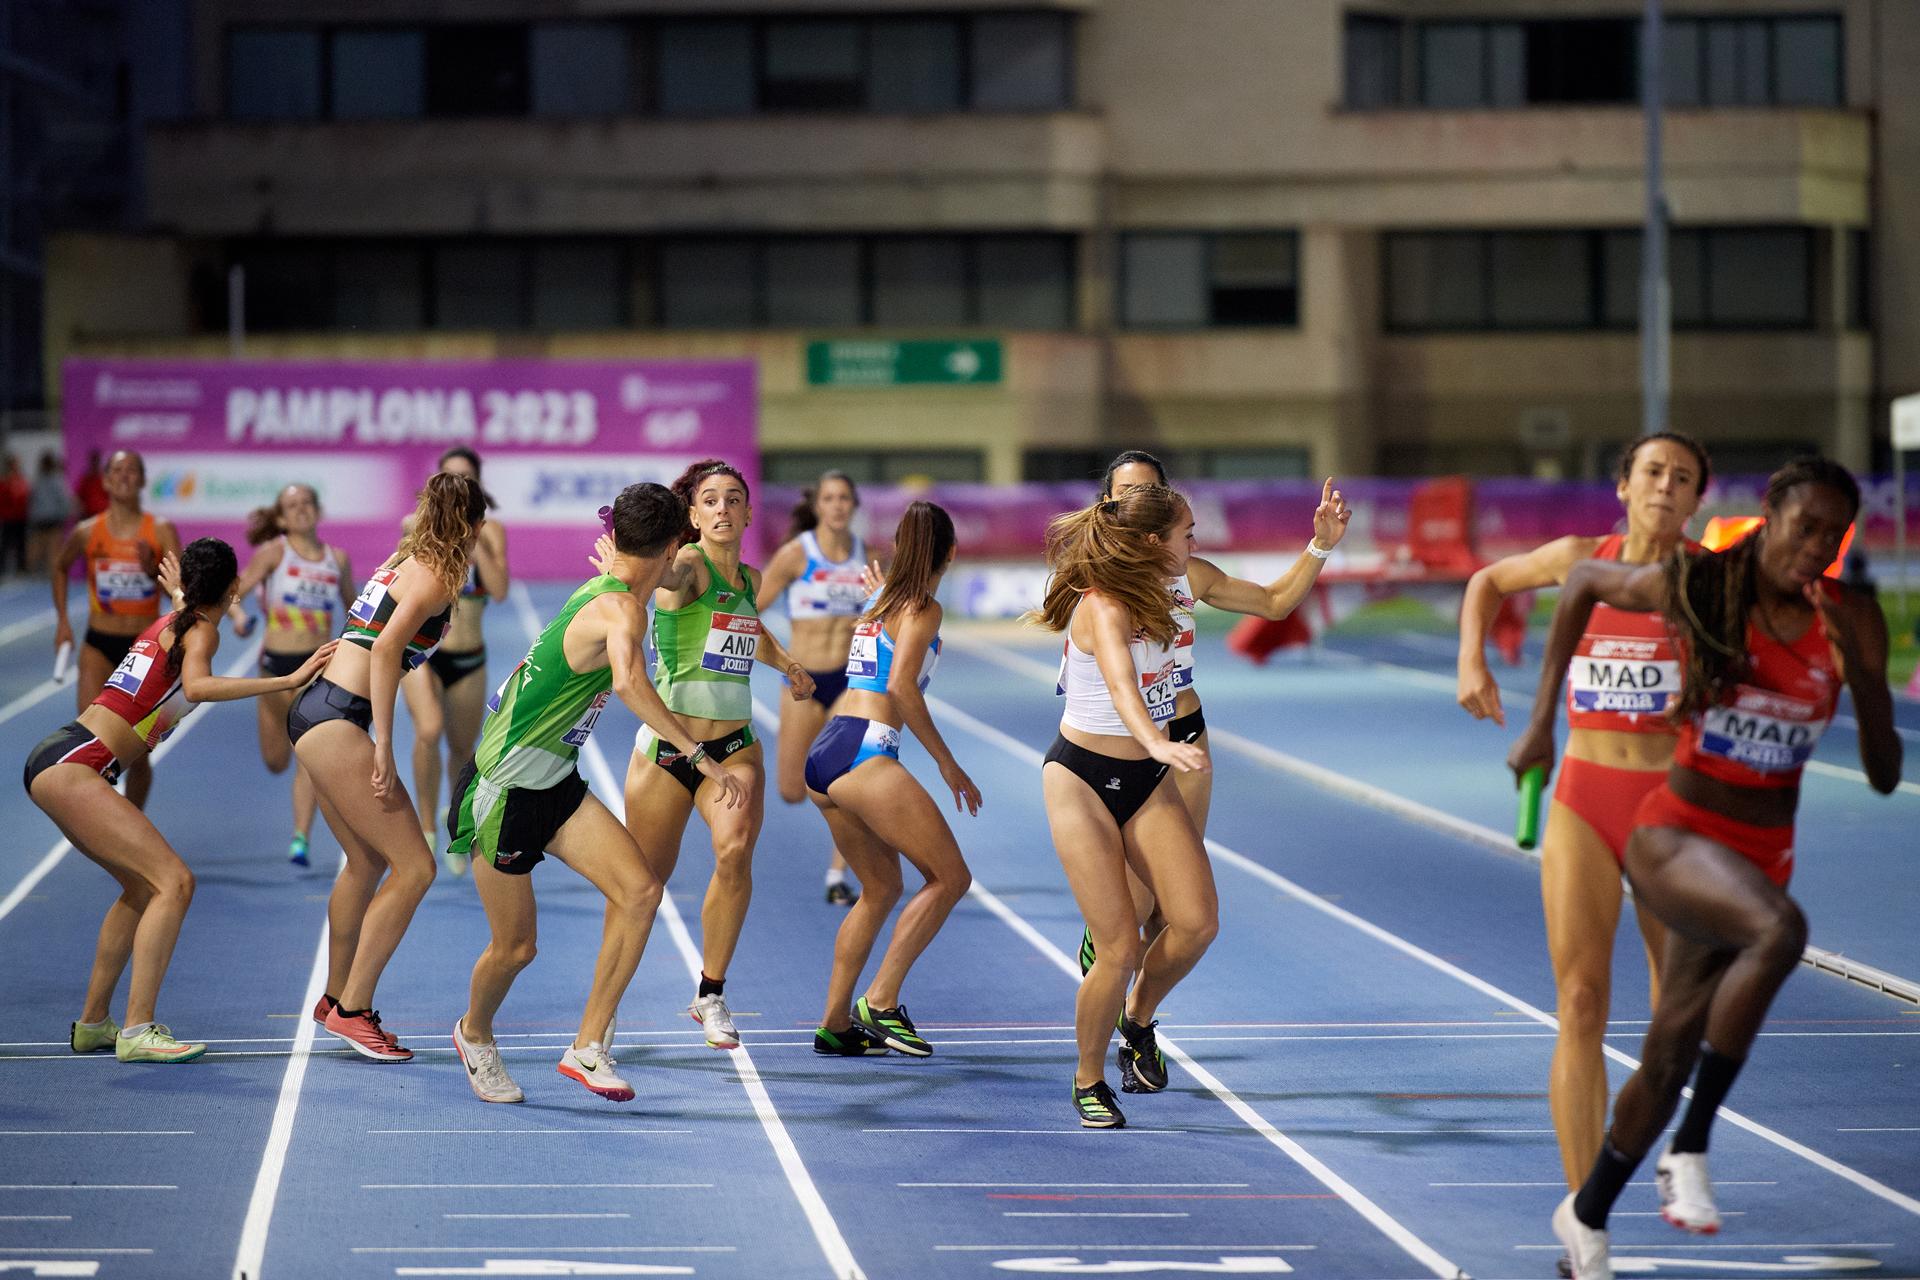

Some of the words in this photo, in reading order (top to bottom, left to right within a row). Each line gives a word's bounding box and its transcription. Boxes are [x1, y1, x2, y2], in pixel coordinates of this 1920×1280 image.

[228, 388, 476, 441] PAMPLONA
[483, 389, 598, 443] 2023
[720, 635, 755, 656] AND
[850, 638, 865, 658] GAL
[1589, 663, 1663, 689] MAD
[1146, 681, 1172, 704] CYL
[1149, 702, 1175, 720] oma
[1724, 714, 1810, 746] MAD
